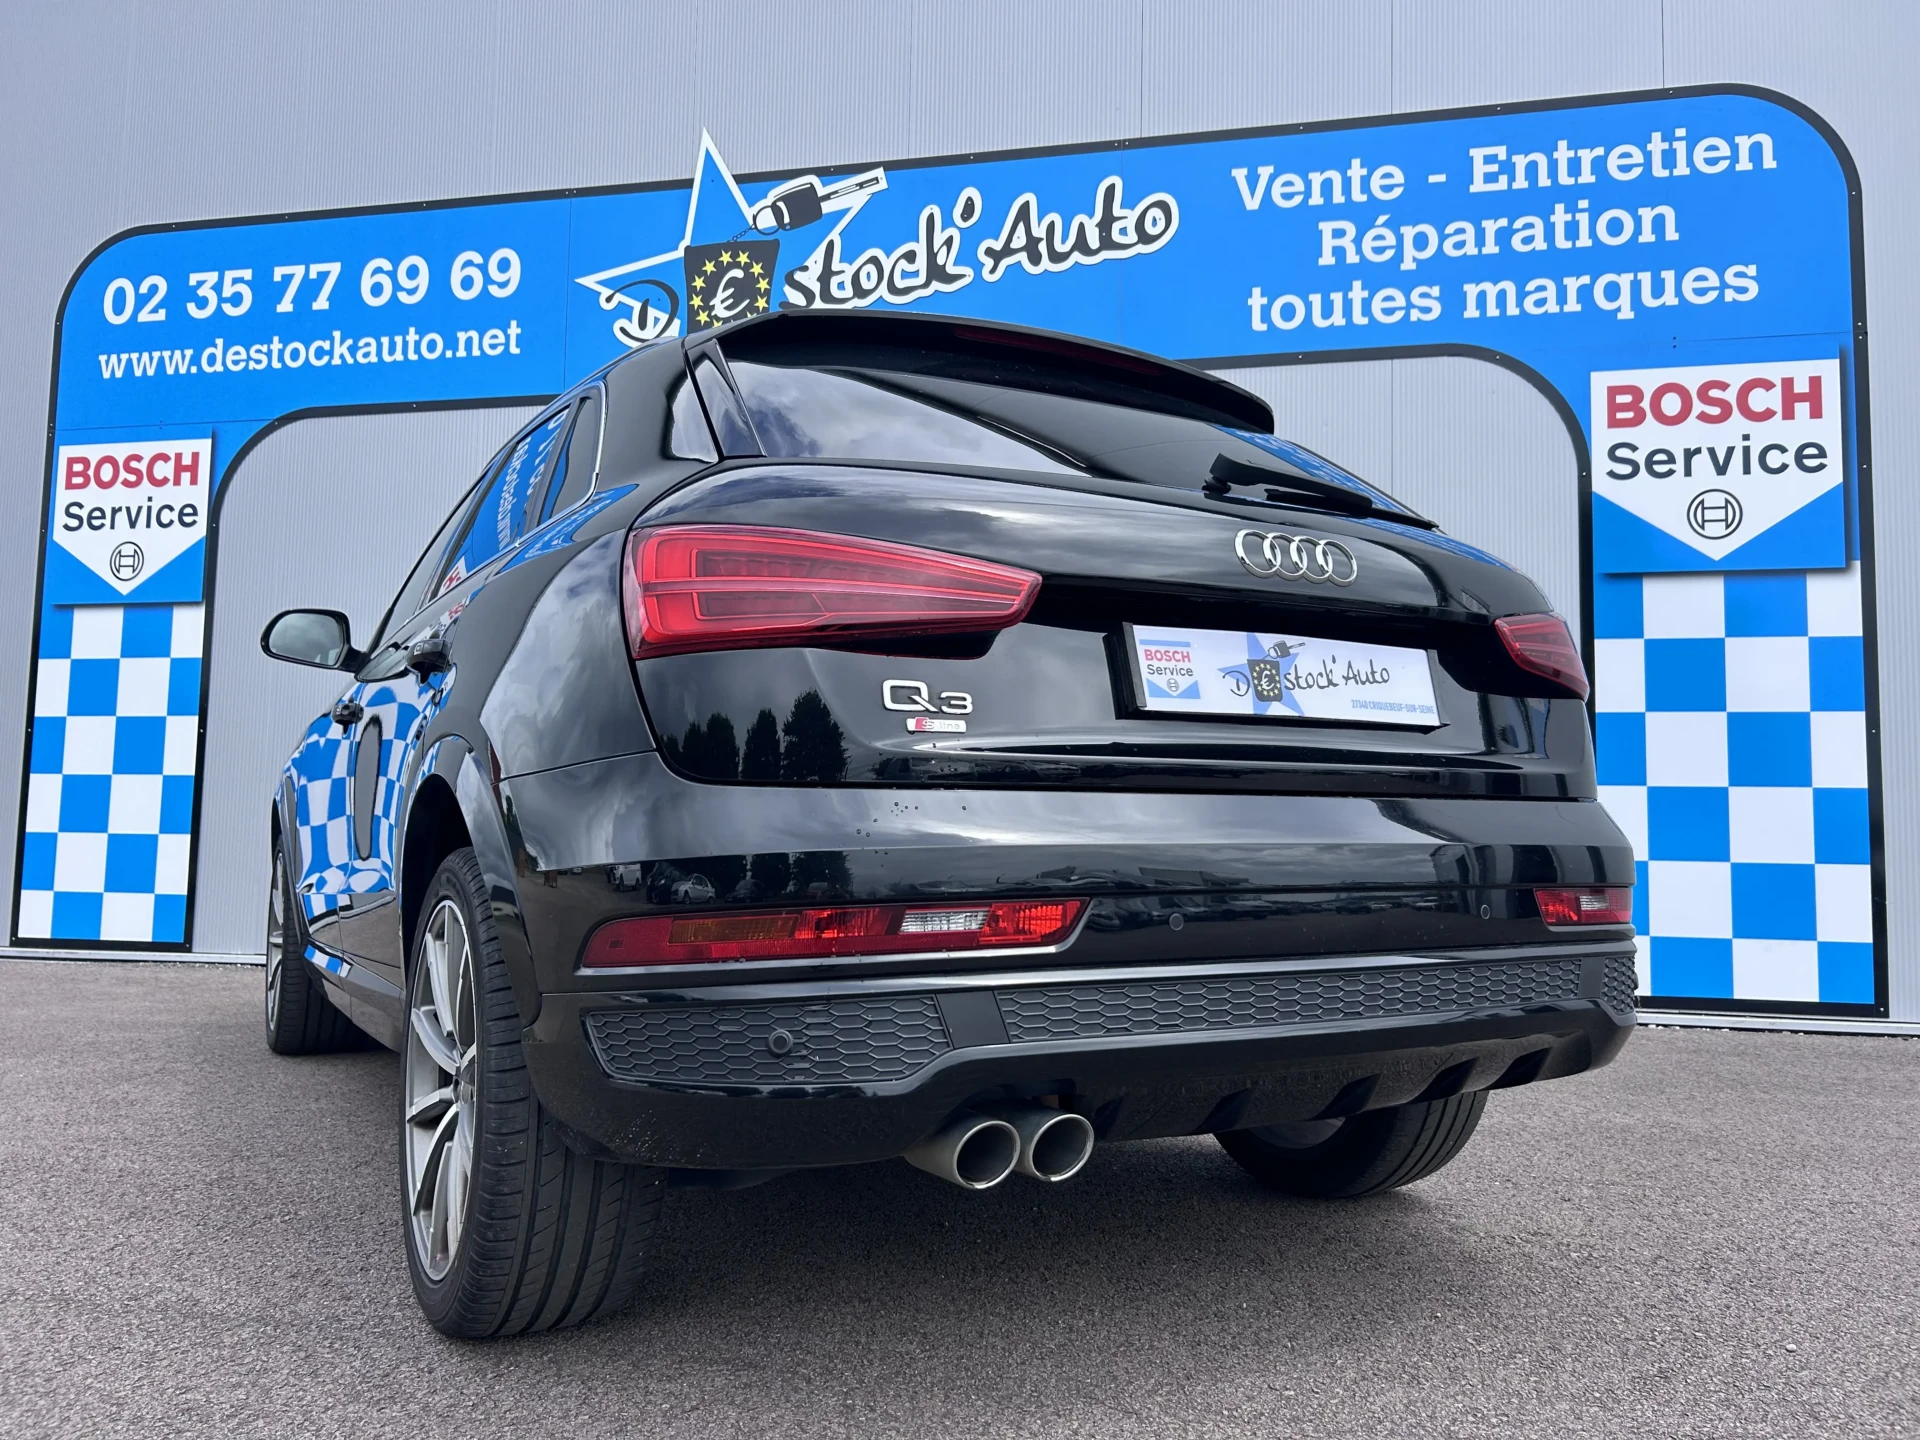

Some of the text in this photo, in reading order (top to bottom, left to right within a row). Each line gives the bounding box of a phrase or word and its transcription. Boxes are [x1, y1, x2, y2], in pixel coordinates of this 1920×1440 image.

[1231, 127, 1777, 211] Vente - Entretien
[984, 182, 1173, 276] Auto
[1318, 199, 1679, 271] Réparation
[103, 247, 522, 325] 02 35 77 69 69
[1248, 262, 1759, 332] toutes marques
[99, 320, 522, 380] www.destockauto.net
[1606, 375, 1823, 430] BOSCH
[64, 450, 200, 491] BOSCH
[1605, 433, 1828, 482] Service
[62, 496, 199, 532] Service
[1144, 649, 1191, 663] BOSCH
[1147, 664, 1193, 677] Service
[1342, 658, 1389, 686] Auto
[882, 679, 973, 714] Q3
